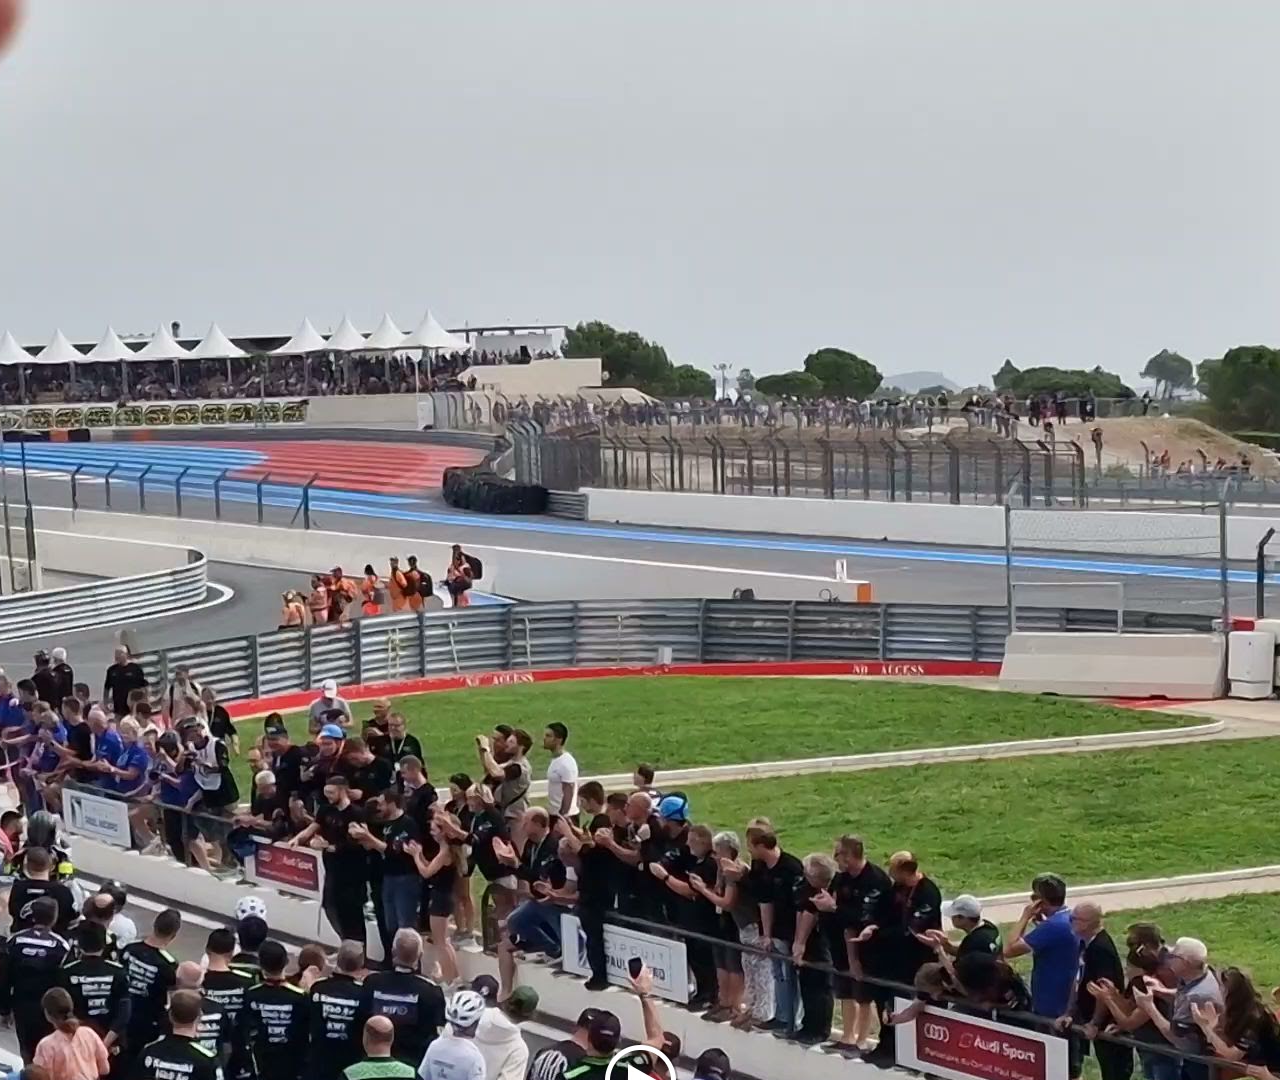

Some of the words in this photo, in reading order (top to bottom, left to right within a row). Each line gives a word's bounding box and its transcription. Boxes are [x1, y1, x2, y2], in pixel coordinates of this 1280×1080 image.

[881, 664, 924, 674] ACCESS
[973, 1034, 1001, 1054] Audi
[1002, 1042, 1036, 1063] Sport
